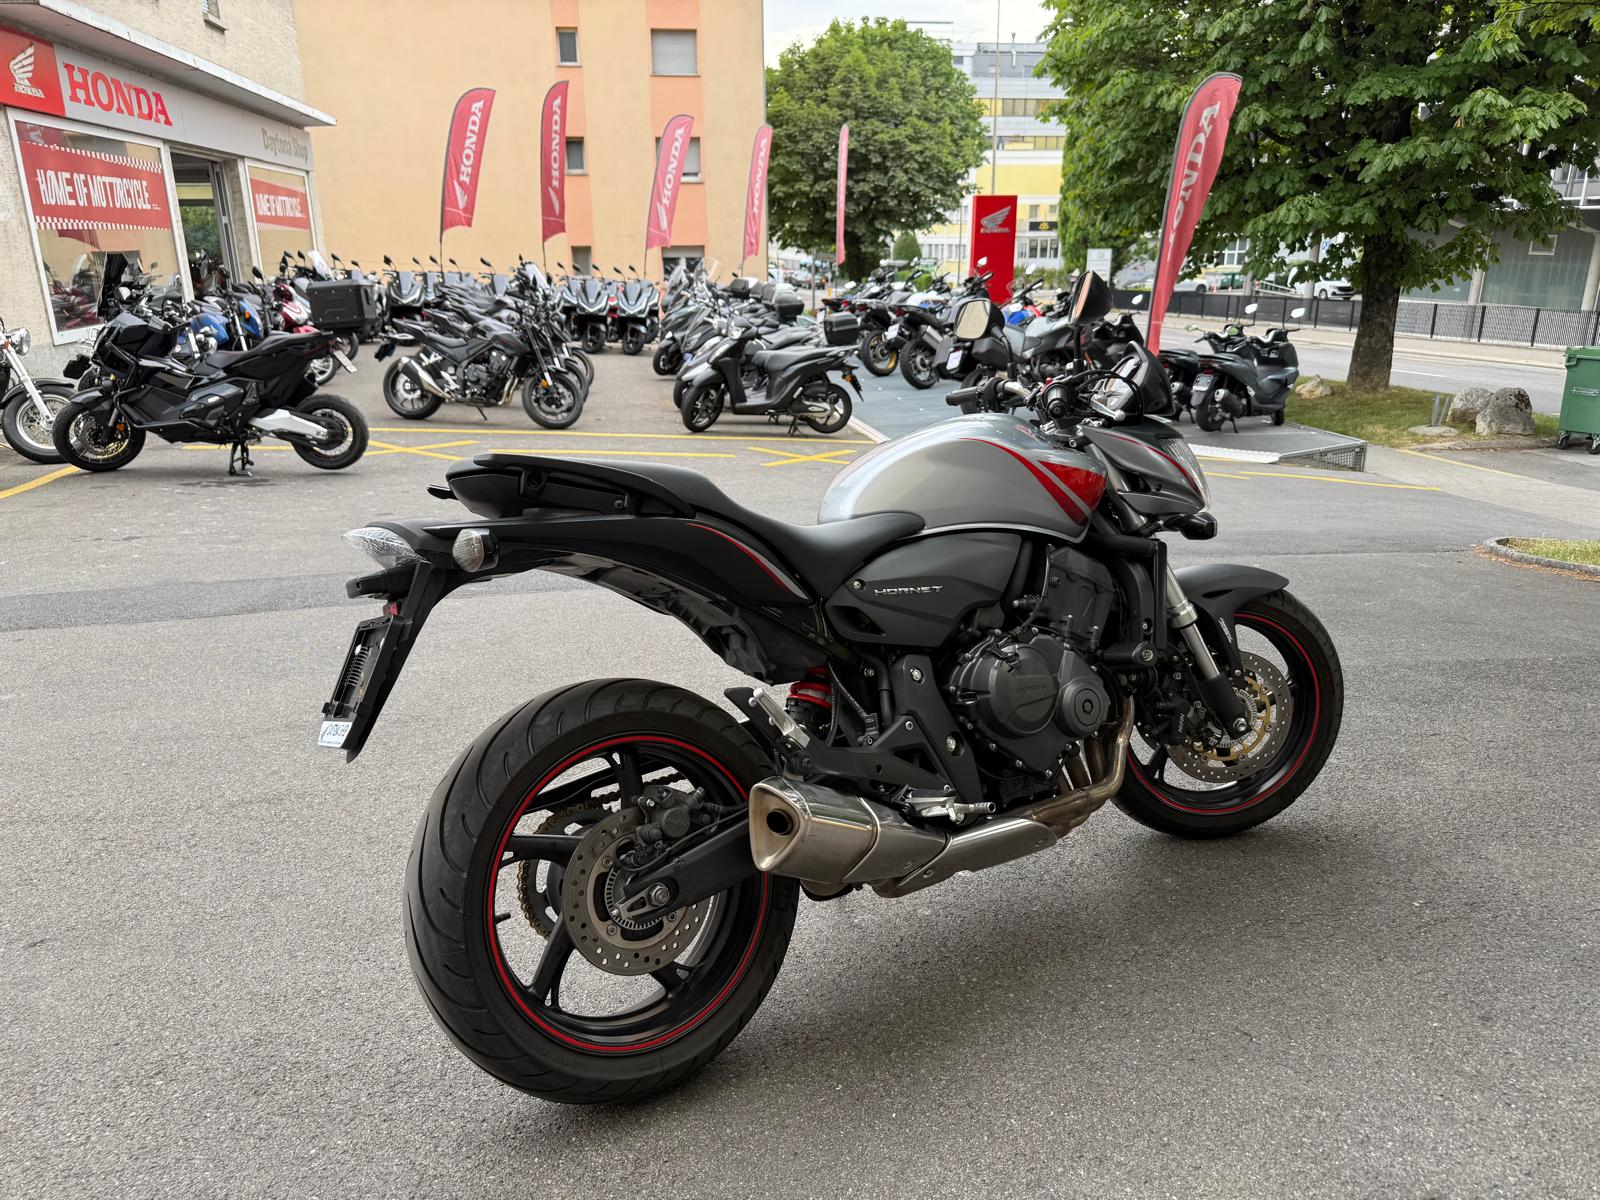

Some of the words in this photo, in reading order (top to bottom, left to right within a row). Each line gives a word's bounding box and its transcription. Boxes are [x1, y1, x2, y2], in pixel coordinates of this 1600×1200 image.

[63, 62, 173, 127] HONDA
[261, 127, 292, 156] Daytona
[459, 100, 484, 185] HONDA
[551, 96, 561, 188] HONDA
[662, 125, 687, 208] HONDA
[36, 169, 76, 206] HOME
[73, 172, 88, 207] OF
[874, 585, 943, 596] HORNET
